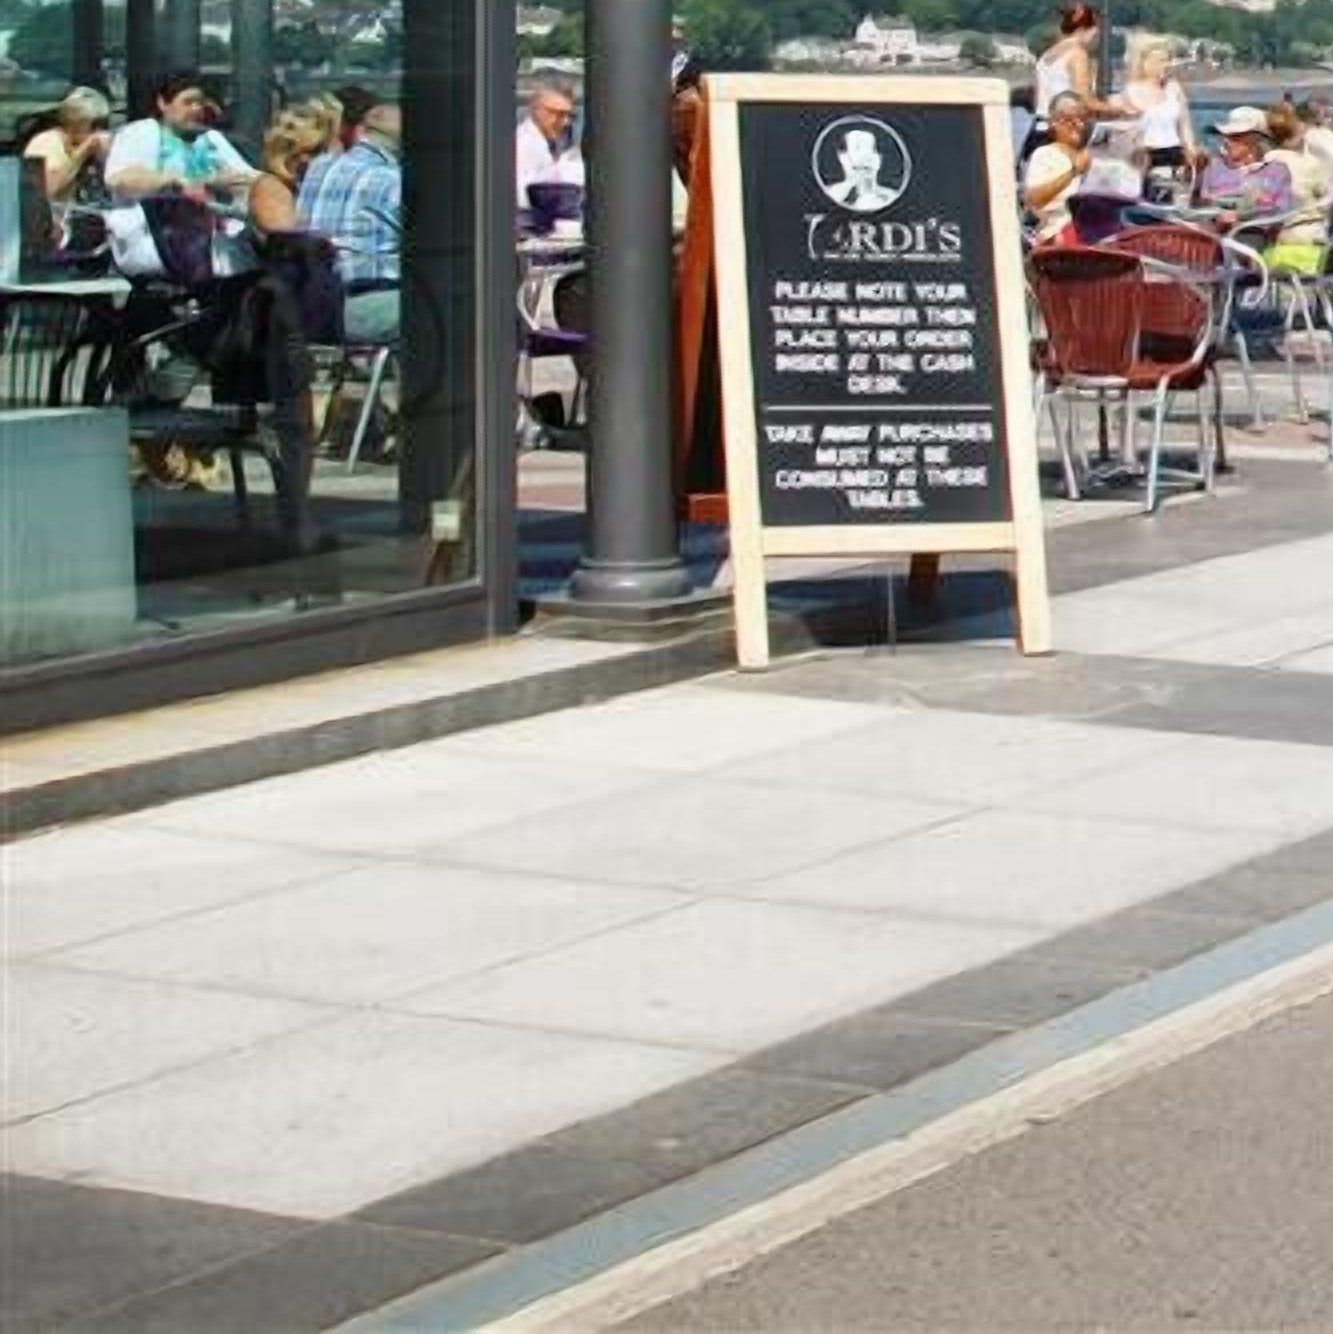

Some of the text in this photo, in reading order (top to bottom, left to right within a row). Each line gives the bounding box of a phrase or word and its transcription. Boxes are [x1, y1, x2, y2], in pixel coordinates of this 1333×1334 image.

[914, 282, 967, 300] YOUR
[775, 328, 838, 347] PLACE
[845, 329, 898, 347] YOUR
